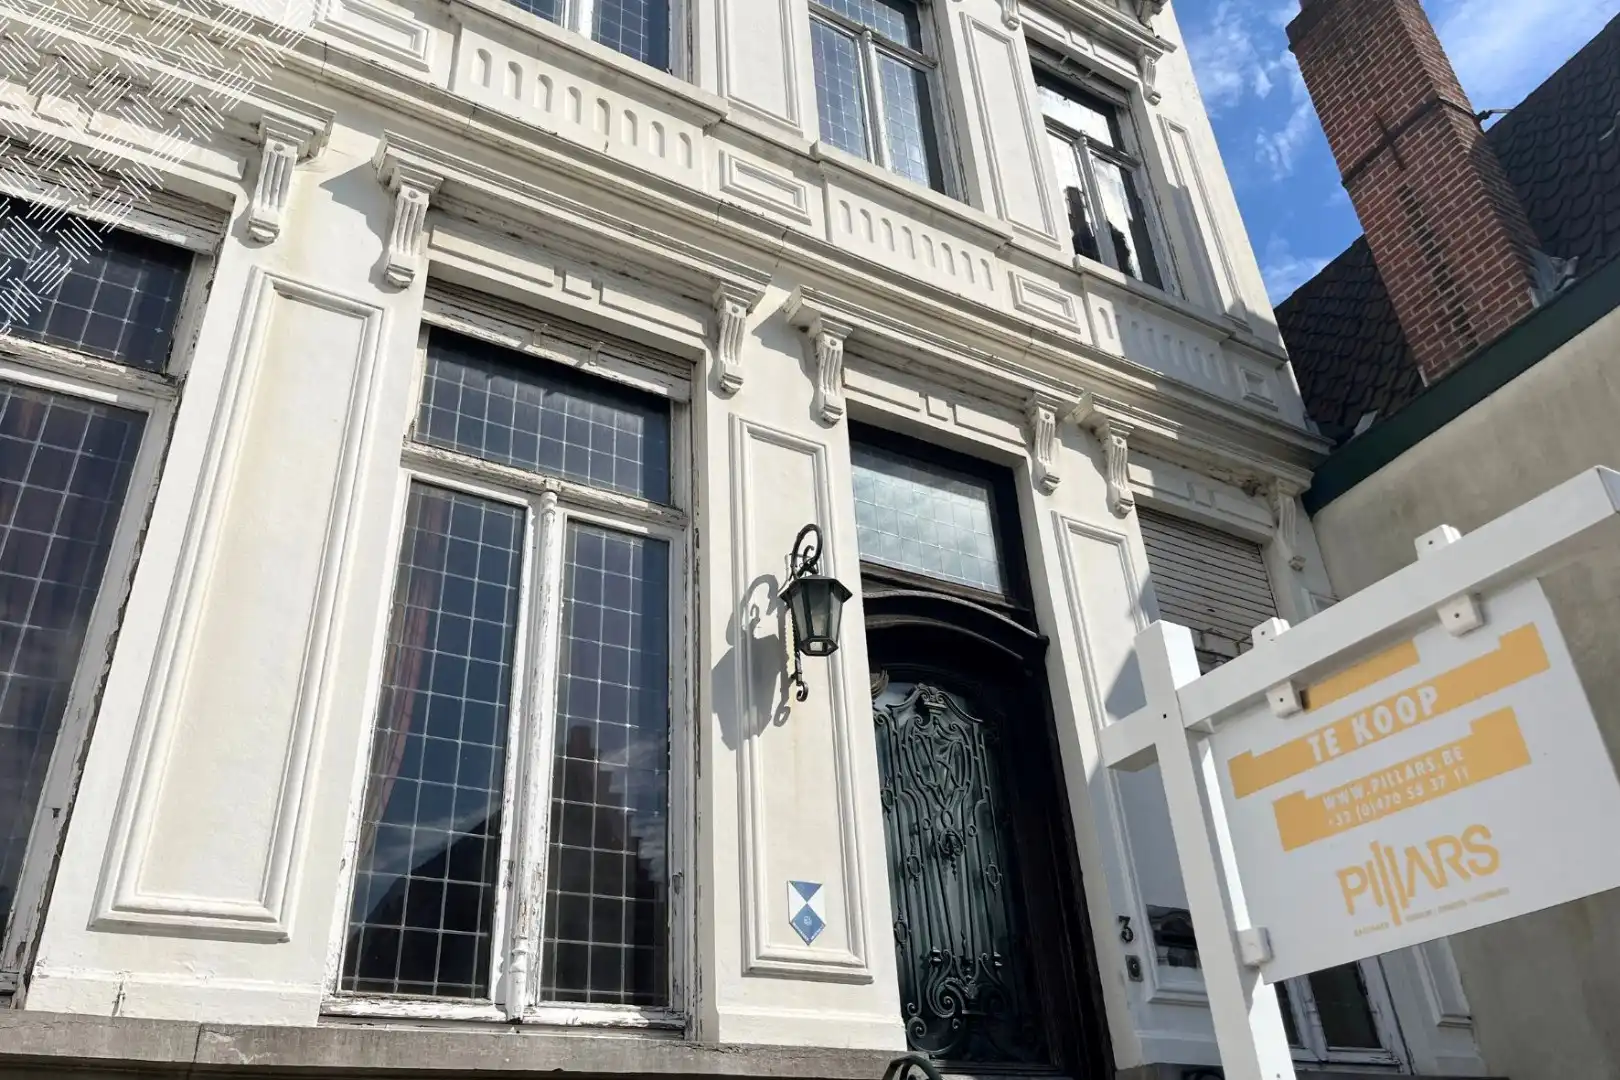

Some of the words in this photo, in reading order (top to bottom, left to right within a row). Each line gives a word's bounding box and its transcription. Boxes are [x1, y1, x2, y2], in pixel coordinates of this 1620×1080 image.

[1307, 728, 1340, 762] TE
[1351, 685, 1438, 745] KOOP
[1322, 746, 1464, 810] WWW.PILLARS.BE
[1118, 915, 1134, 943] 3
